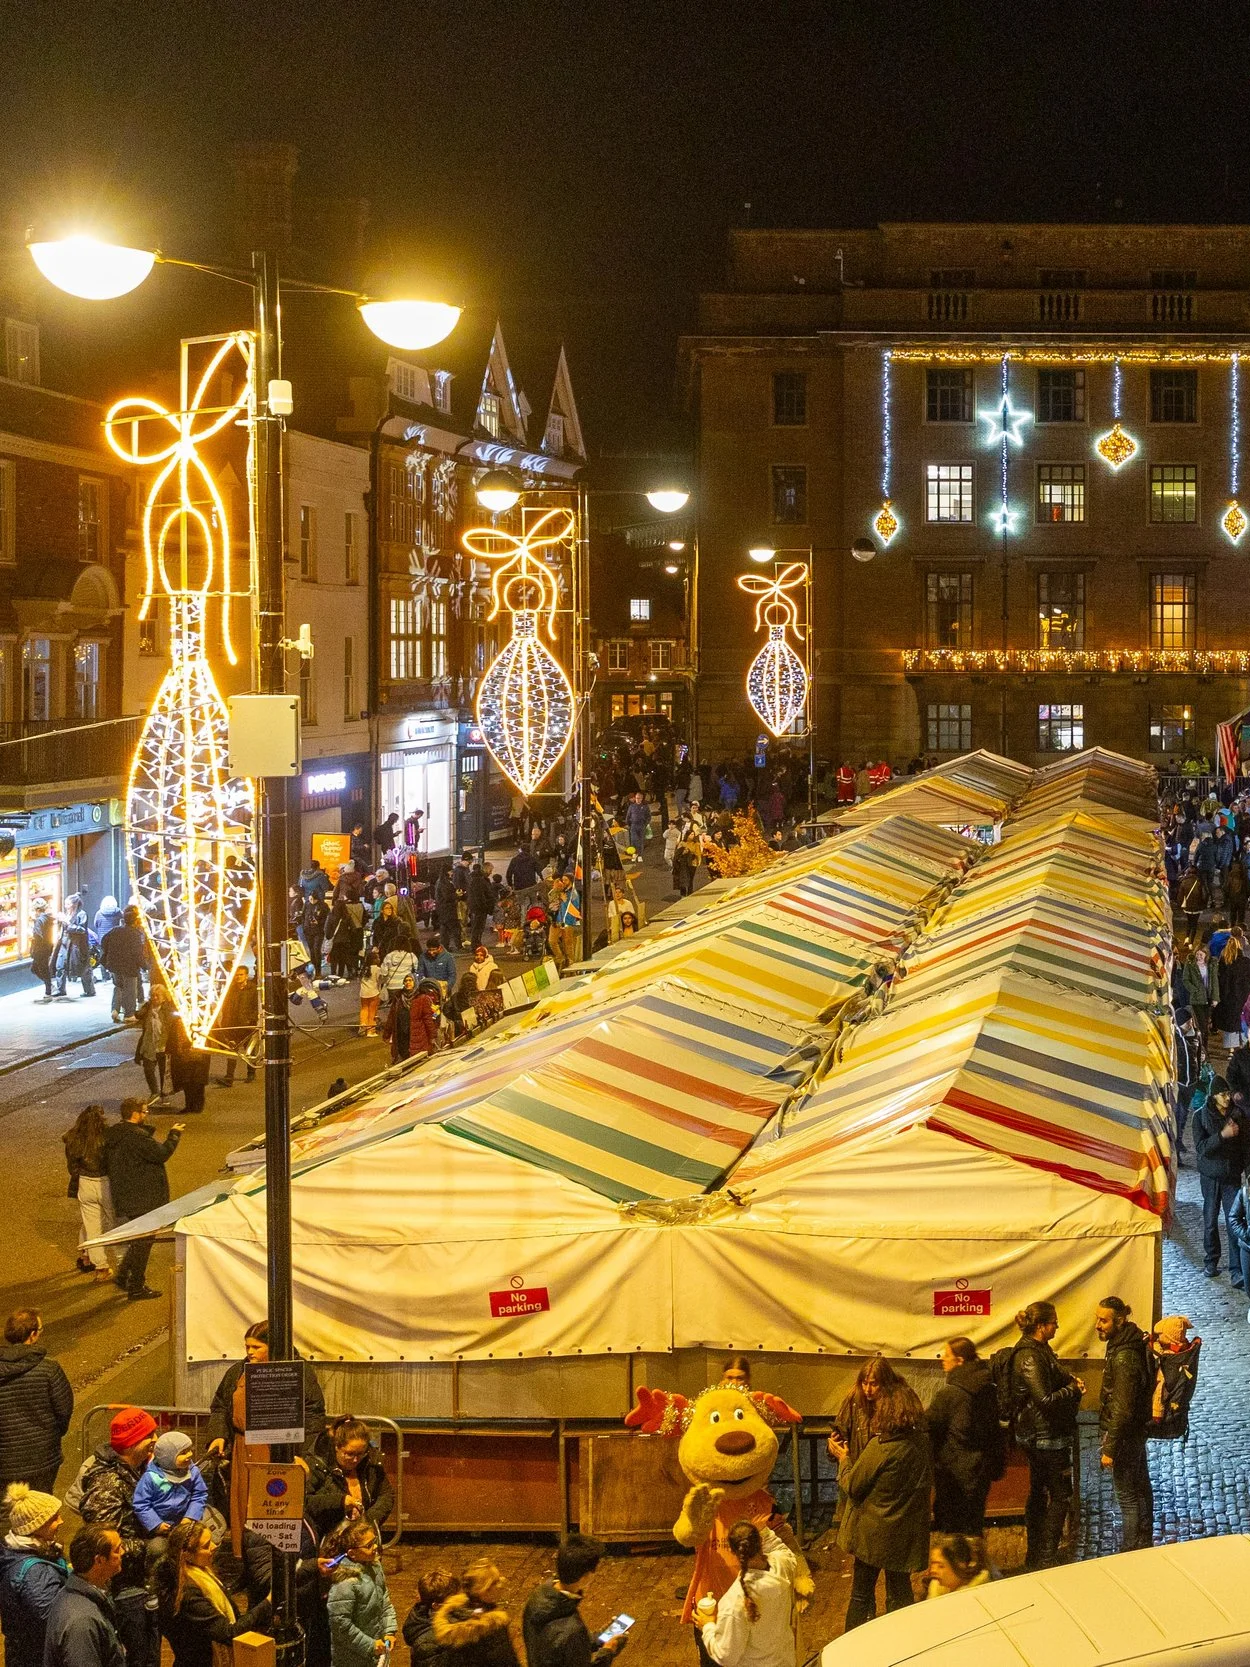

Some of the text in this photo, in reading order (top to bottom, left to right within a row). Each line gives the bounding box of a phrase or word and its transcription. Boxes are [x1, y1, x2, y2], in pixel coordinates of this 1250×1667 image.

[510, 1292, 527, 1303] No
[954, 1293, 970, 1303] No
[498, 1302, 542, 1315] parking
[941, 1303, 983, 1314] parking
[266, 1522, 296, 1531] loading
[278, 1532, 293, 1540] Sat
[285, 1542, 298, 1550] pm
